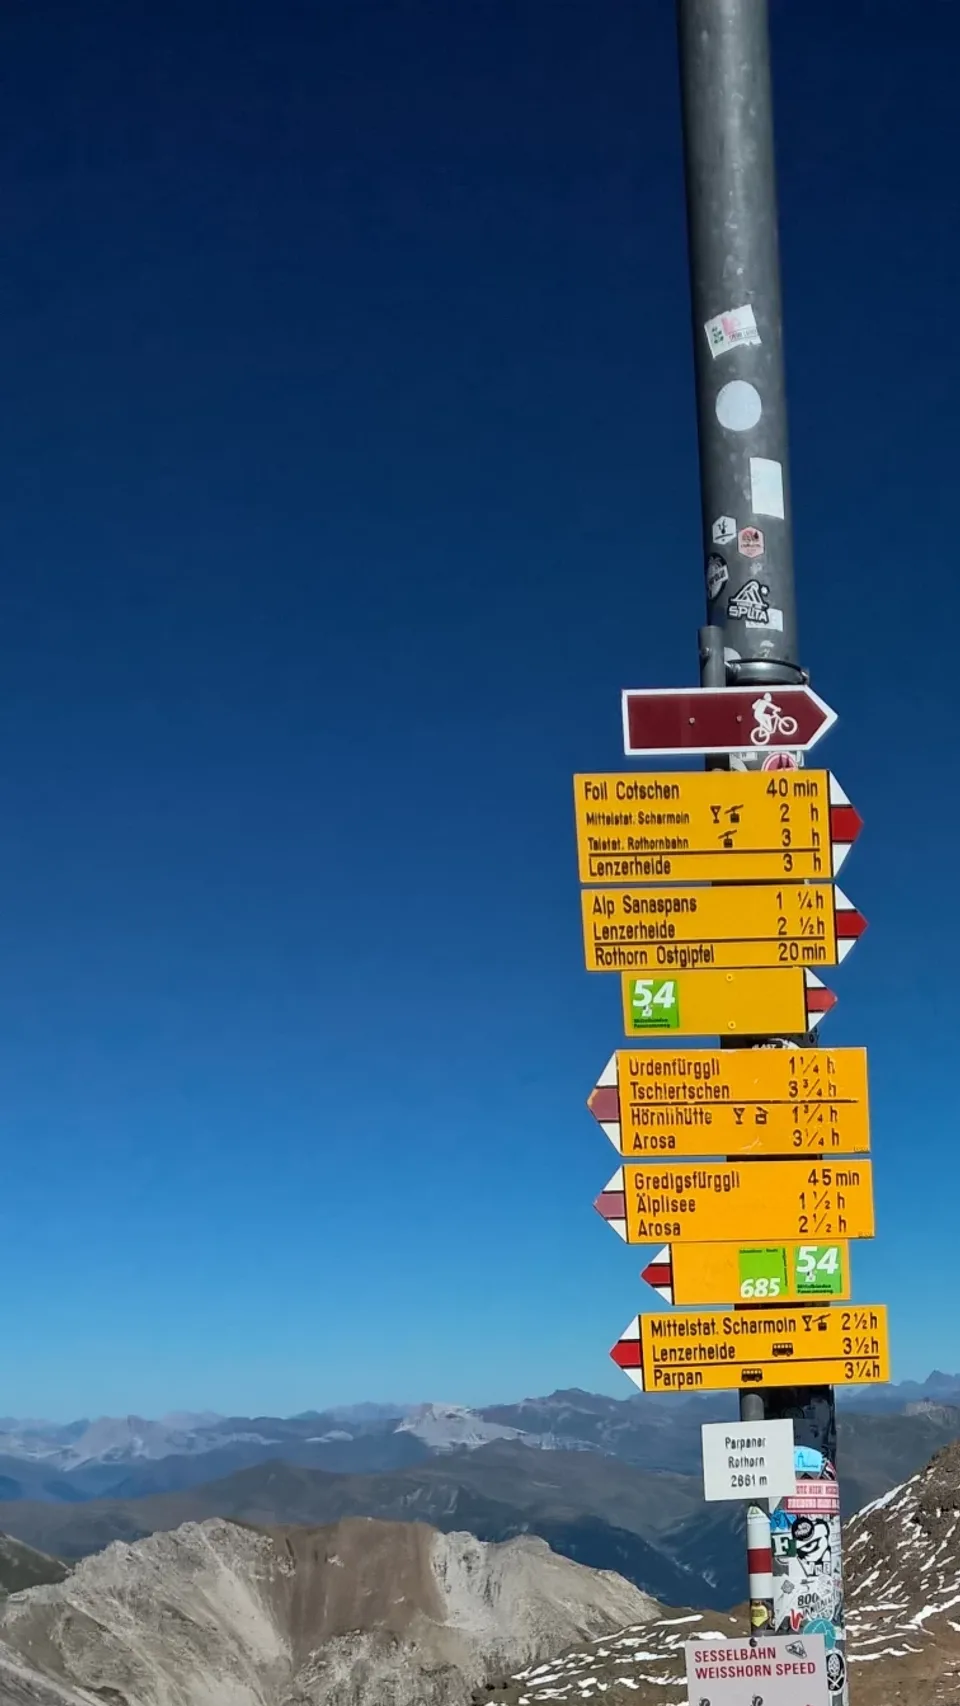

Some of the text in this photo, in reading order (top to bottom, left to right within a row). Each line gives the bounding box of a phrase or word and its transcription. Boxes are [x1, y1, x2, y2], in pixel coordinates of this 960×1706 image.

[584, 778, 818, 801] Foil Cotschen 40 min
[586, 802, 819, 826] Mittelstat. Scharmoin 2 h
[628, 836, 689, 850] Rothornbahn
[782, 828, 792, 847] 3
[812, 828, 820, 847] h
[589, 852, 822, 876] Lenzerheide 3 h
[592, 896, 615, 919] Alp
[622, 894, 697, 918] Sanaspans
[776, 891, 783, 910] 1
[816, 890, 824, 909] h
[593, 920, 676, 940] Lenzerheide
[777, 917, 787, 935] 2
[817, 916, 825, 935] h
[594, 942, 826, 968] Rothorn Ostgipfel 20 min
[632, 980, 676, 1008] 54
[629, 1057, 720, 1080] Urdenfürggli
[827, 1056, 835, 1074] h
[630, 1082, 730, 1100] Tschiertschen
[788, 1080, 798, 1098] 3
[828, 1080, 836, 1097] h
[631, 1107, 712, 1126] Hörnlihütte
[830, 1106, 838, 1123] h
[633, 1132, 676, 1150] Arosa
[793, 1129, 802, 1147] 3
[832, 1128, 840, 1146] h
[634, 1168, 860, 1194] Gredigsfürggli 45 min
[636, 1192, 696, 1217] Älplisee
[799, 1192, 805, 1210] 1
[837, 1192, 845, 1209] h
[638, 1219, 681, 1237] Arosa
[798, 1215, 808, 1233] 2
[839, 1215, 846, 1233] h
[796, 1246, 839, 1274] 54
[740, 1278, 780, 1298] 685
[651, 1318, 718, 1338] Mittelstat.
[723, 1317, 796, 1335] Scharmoin
[652, 1342, 735, 1362] Lenzerheide
[654, 1369, 703, 1389] Parpan
[725, 1436, 766, 1451] Parpaner
[728, 1456, 765, 1468] Rothorn
[759, 1476, 768, 1486] m
[694, 1647, 776, 1663] SESSELBAHN
[695, 1662, 816, 1679] WEISSHORN SPEED
